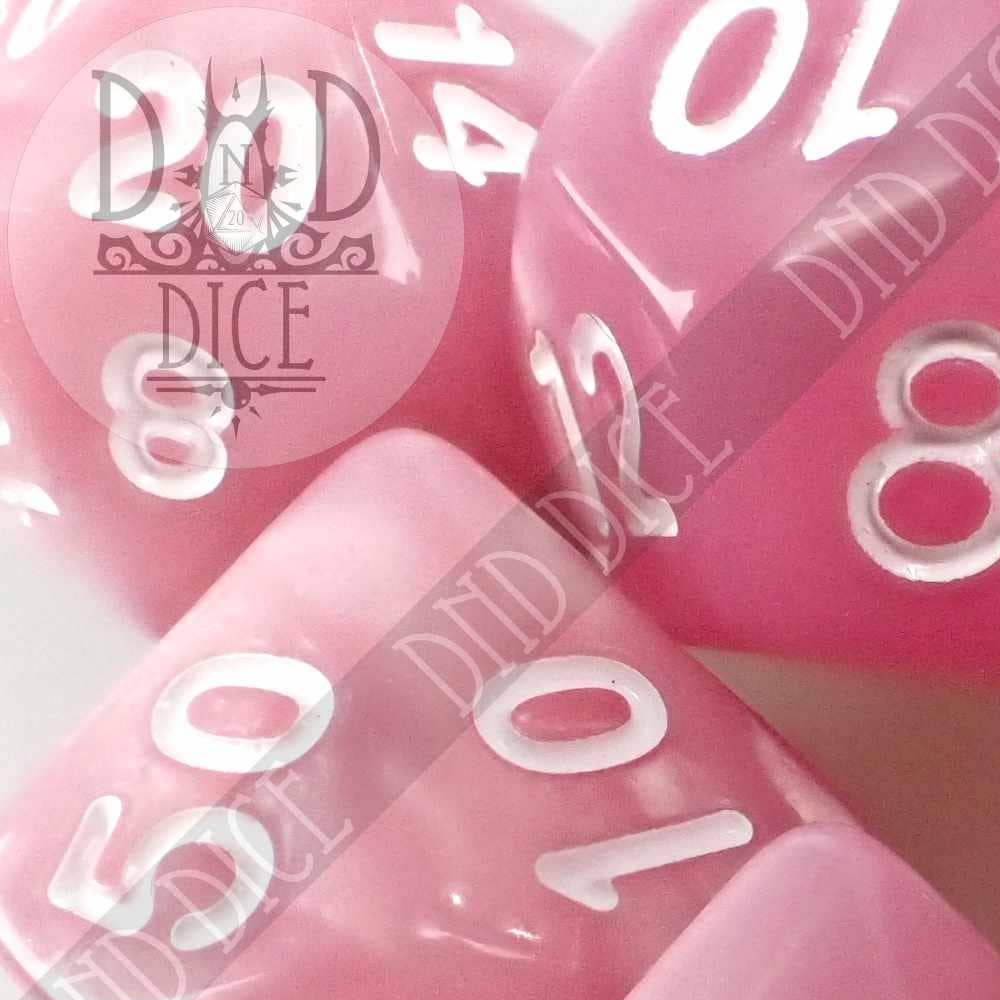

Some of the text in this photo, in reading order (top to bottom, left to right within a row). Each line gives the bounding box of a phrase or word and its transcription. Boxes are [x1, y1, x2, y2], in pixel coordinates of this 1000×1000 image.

[373, 3, 538, 187] 14
[650, 0, 898, 161] 10
[102, 332, 236, 501] 8
[529, 312, 679, 548] 12
[48, 652, 335, 951] 50
[472, 654, 754, 912] 10
